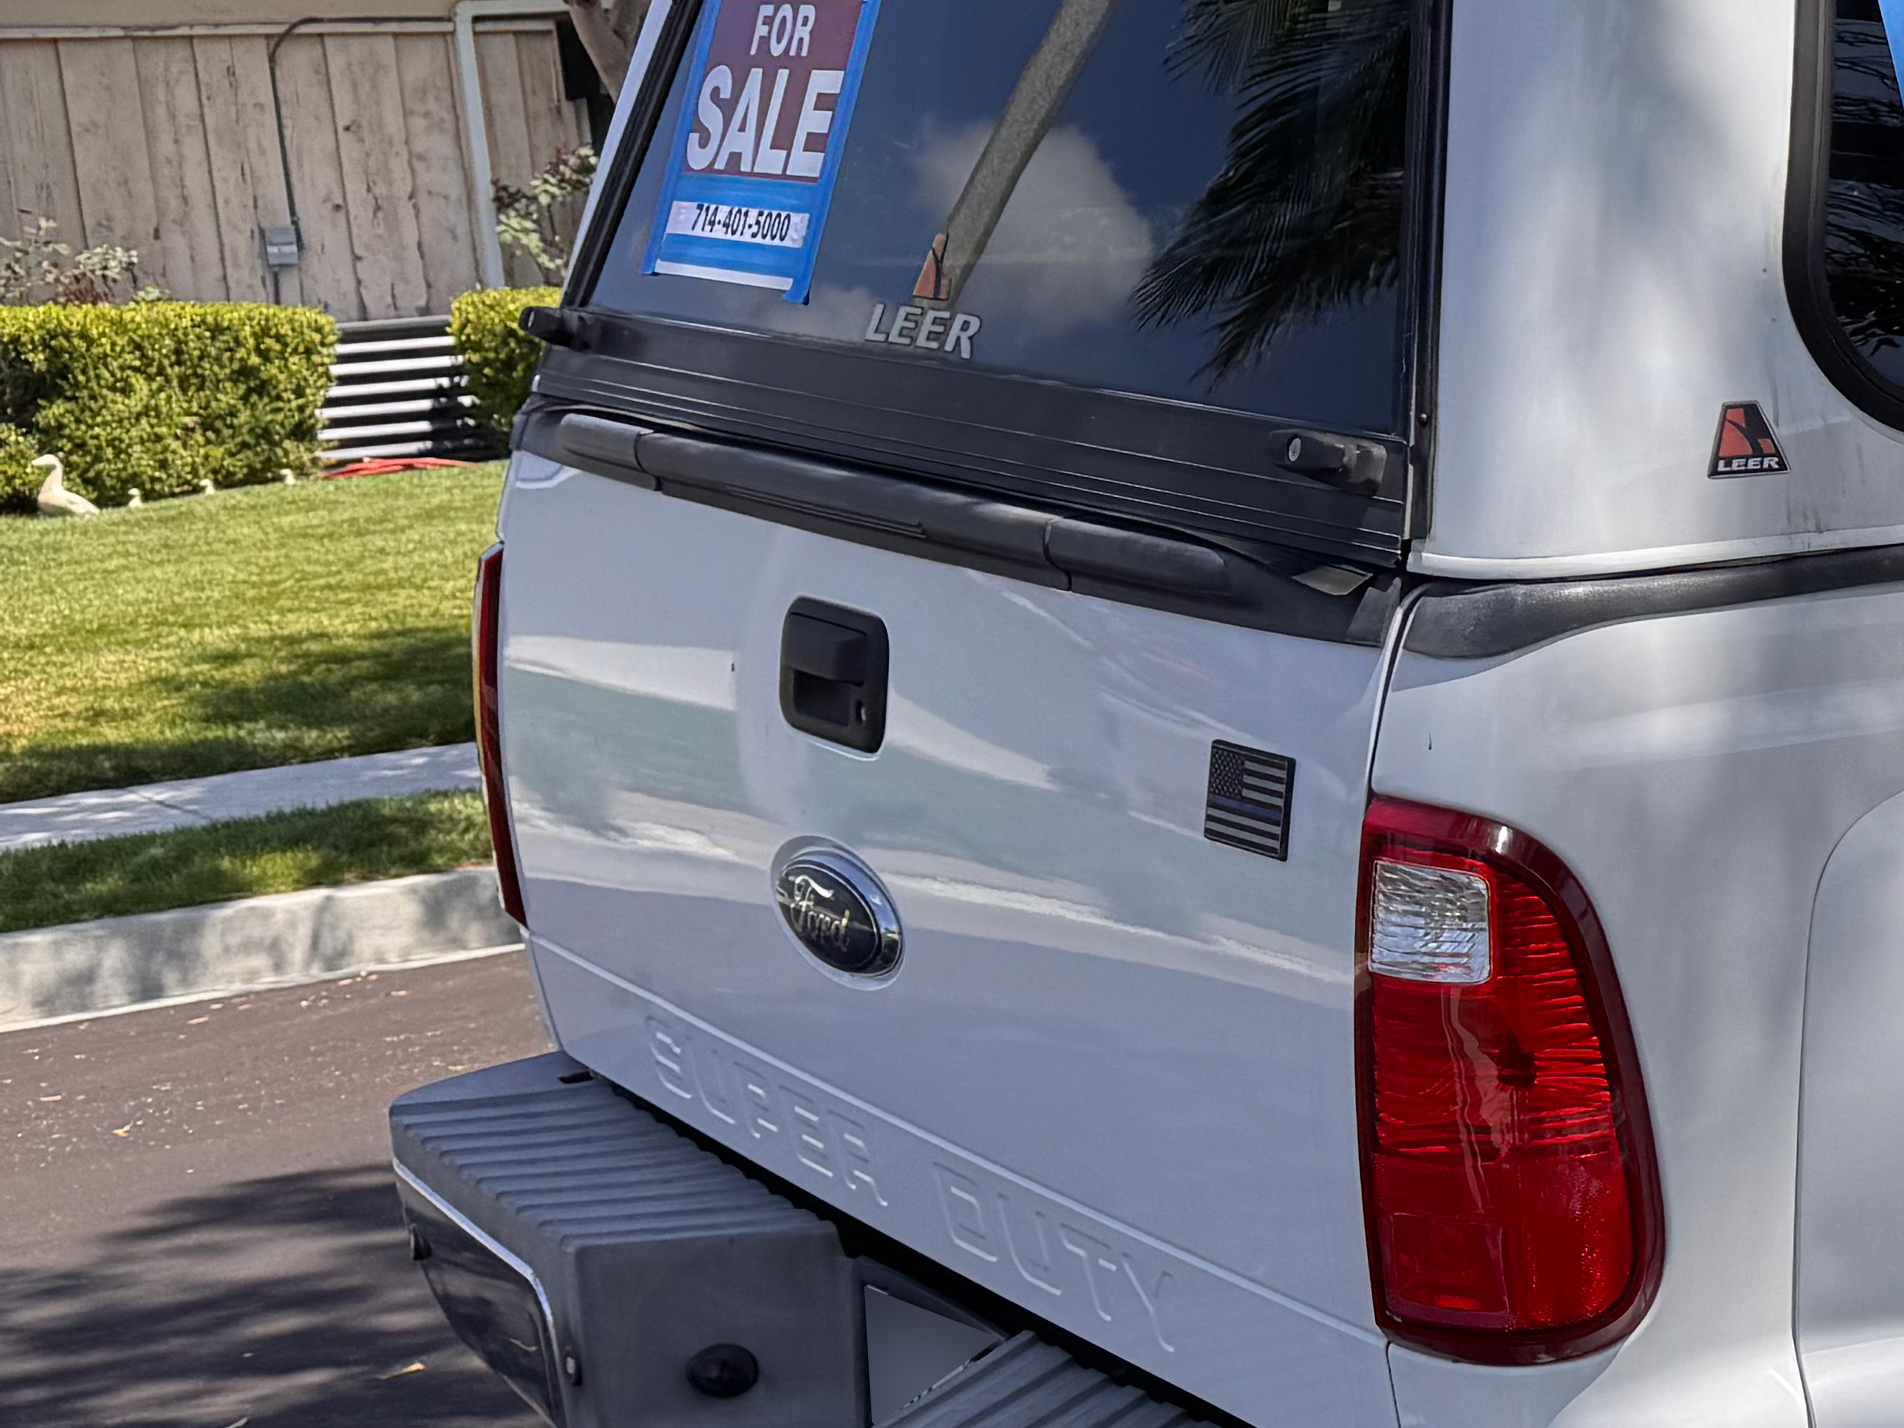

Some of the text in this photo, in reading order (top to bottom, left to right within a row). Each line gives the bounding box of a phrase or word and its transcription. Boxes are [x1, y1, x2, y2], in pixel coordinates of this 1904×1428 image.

[750, 3, 816, 58] FOR
[686, 64, 845, 178] SALE
[690, 203, 792, 243] 714-401-5000
[864, 303, 982, 360] LEER
[1717, 456, 1780, 472] LEER
[644, 1013, 1176, 1354] SUPER DUTY
